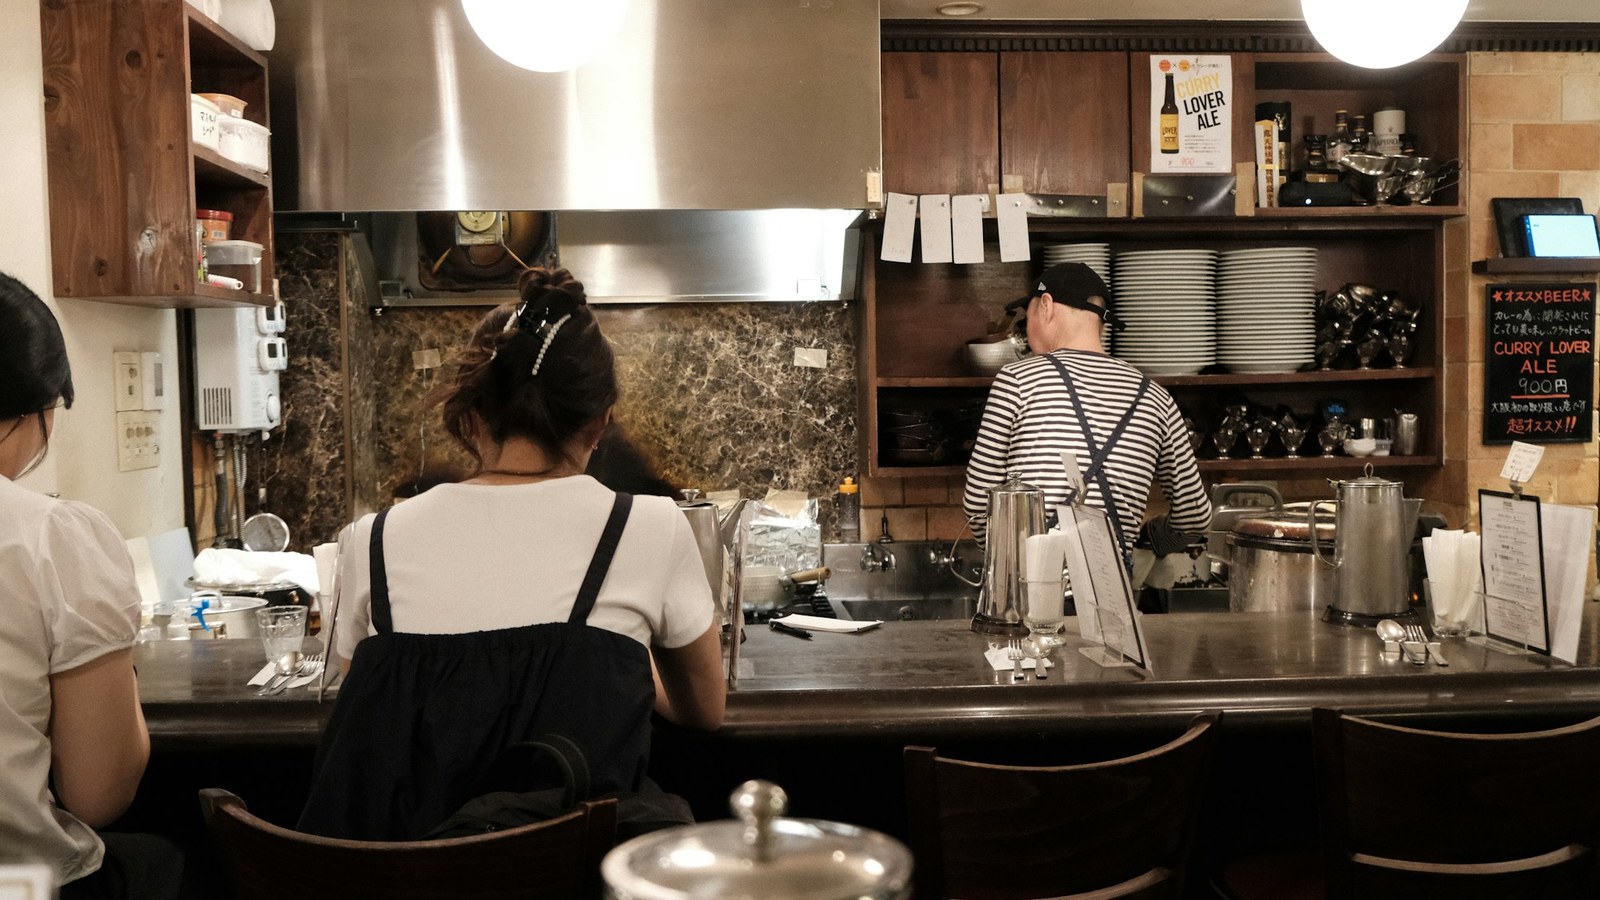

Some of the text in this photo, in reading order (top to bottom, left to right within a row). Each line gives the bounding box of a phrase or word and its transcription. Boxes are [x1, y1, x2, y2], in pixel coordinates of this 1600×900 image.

[1176, 73, 1219, 99] CURRY
[1183, 90, 1226, 115] LOVER
[1197, 109, 1221, 131] ALE
[1494, 340, 1591, 356] CURRY LOVER
[1520, 359, 1558, 374] ALE
[1519, 378, 1568, 395] 900円
